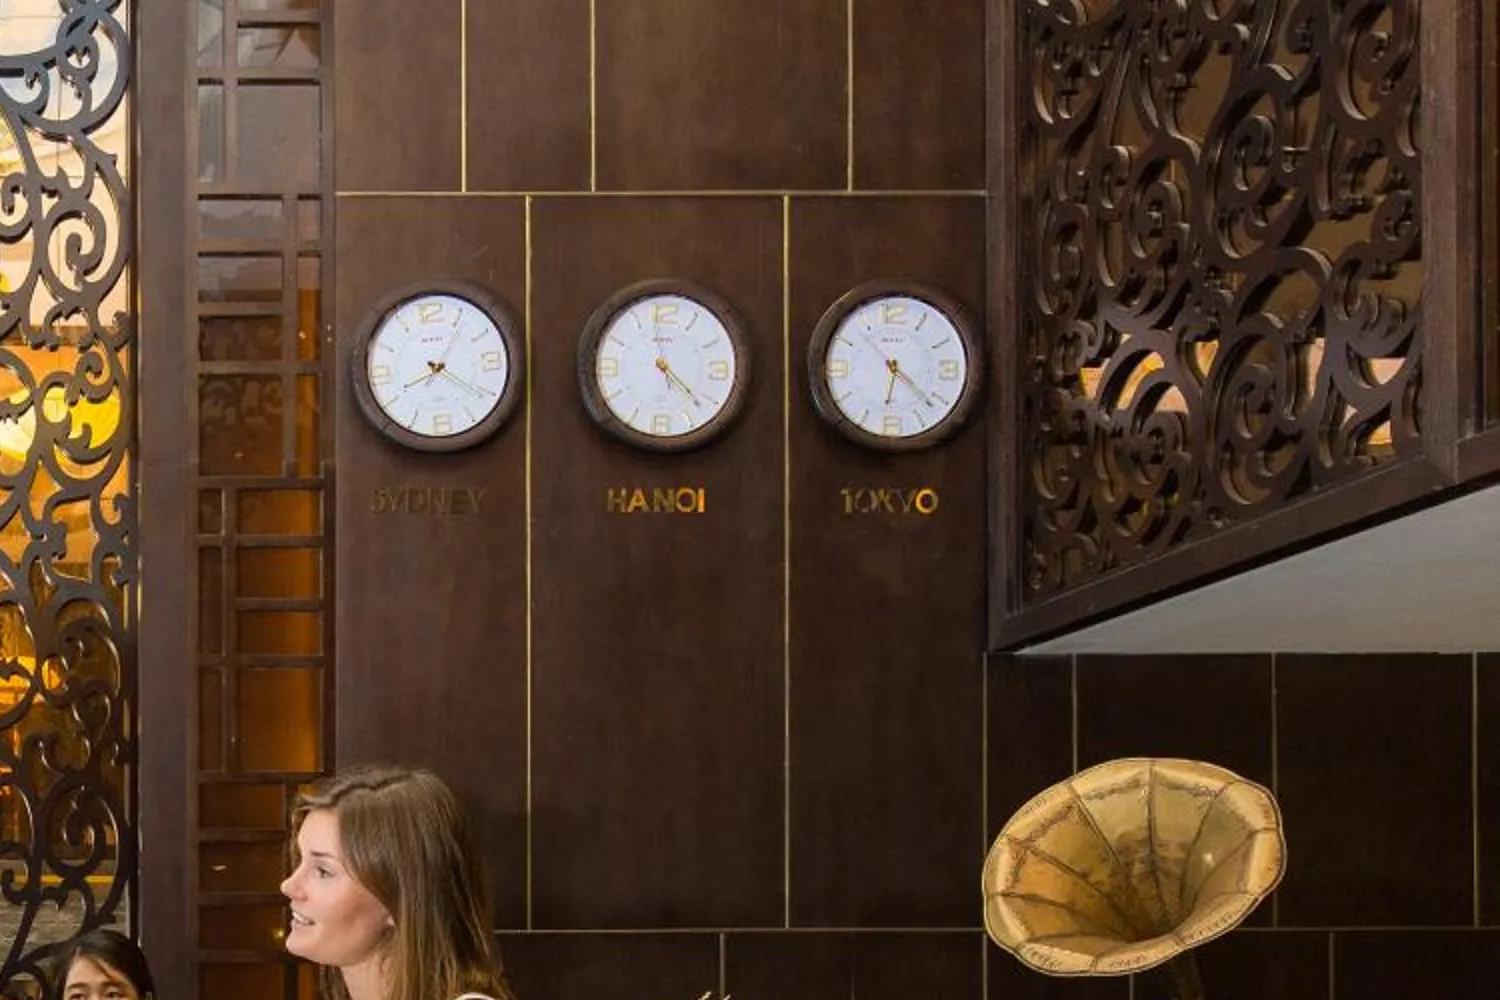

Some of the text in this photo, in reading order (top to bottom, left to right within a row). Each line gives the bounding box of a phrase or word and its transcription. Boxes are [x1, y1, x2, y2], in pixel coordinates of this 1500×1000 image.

[370, 485, 485, 515] SYDNEY
[607, 486, 706, 514] HANOI
[840, 486, 940, 515] TOKYO
